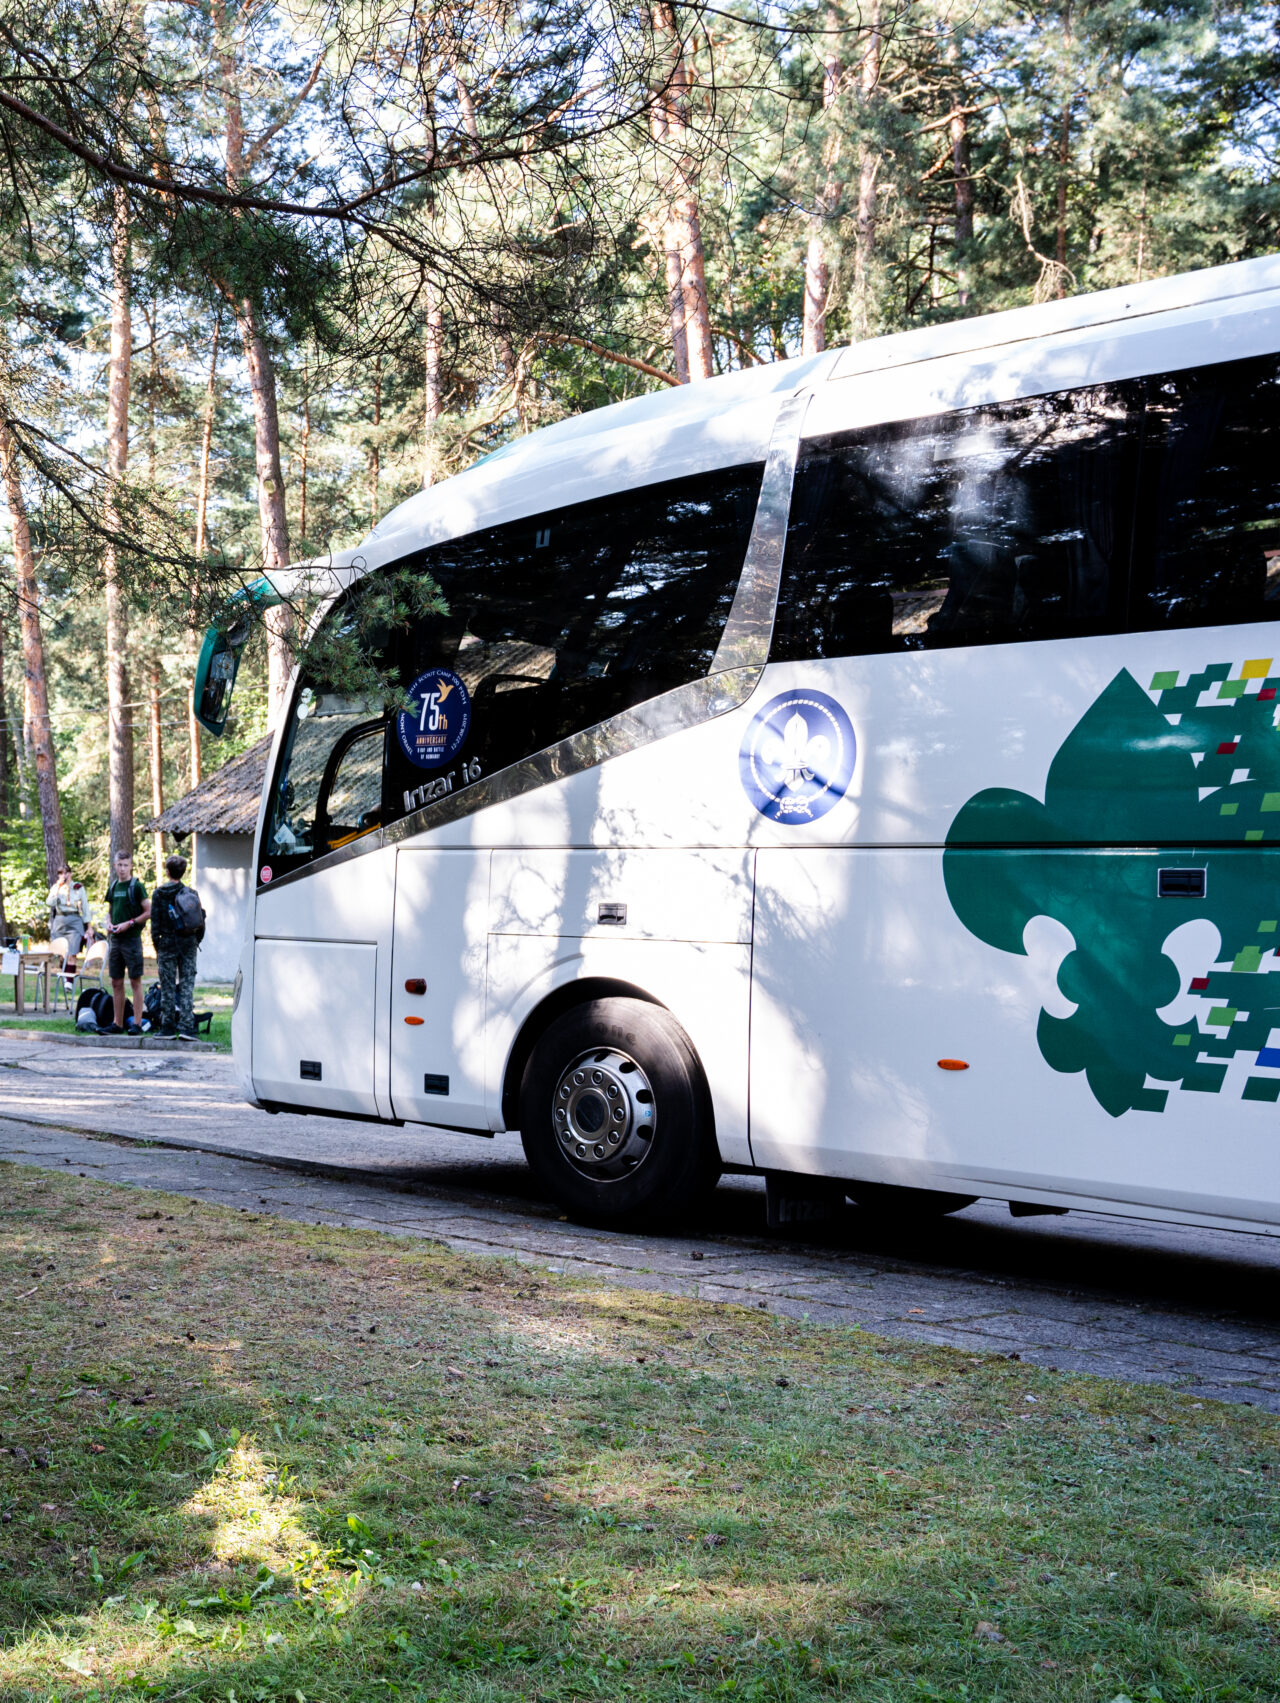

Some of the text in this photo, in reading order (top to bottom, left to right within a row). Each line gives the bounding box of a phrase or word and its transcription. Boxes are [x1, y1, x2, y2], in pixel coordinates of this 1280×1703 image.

[452, 676, 460, 686] 100
[401, 735, 413, 756] ORMEL
[416, 735, 447, 745] ANNIVERSARY
[403, 756, 482, 812] Irizar i6
